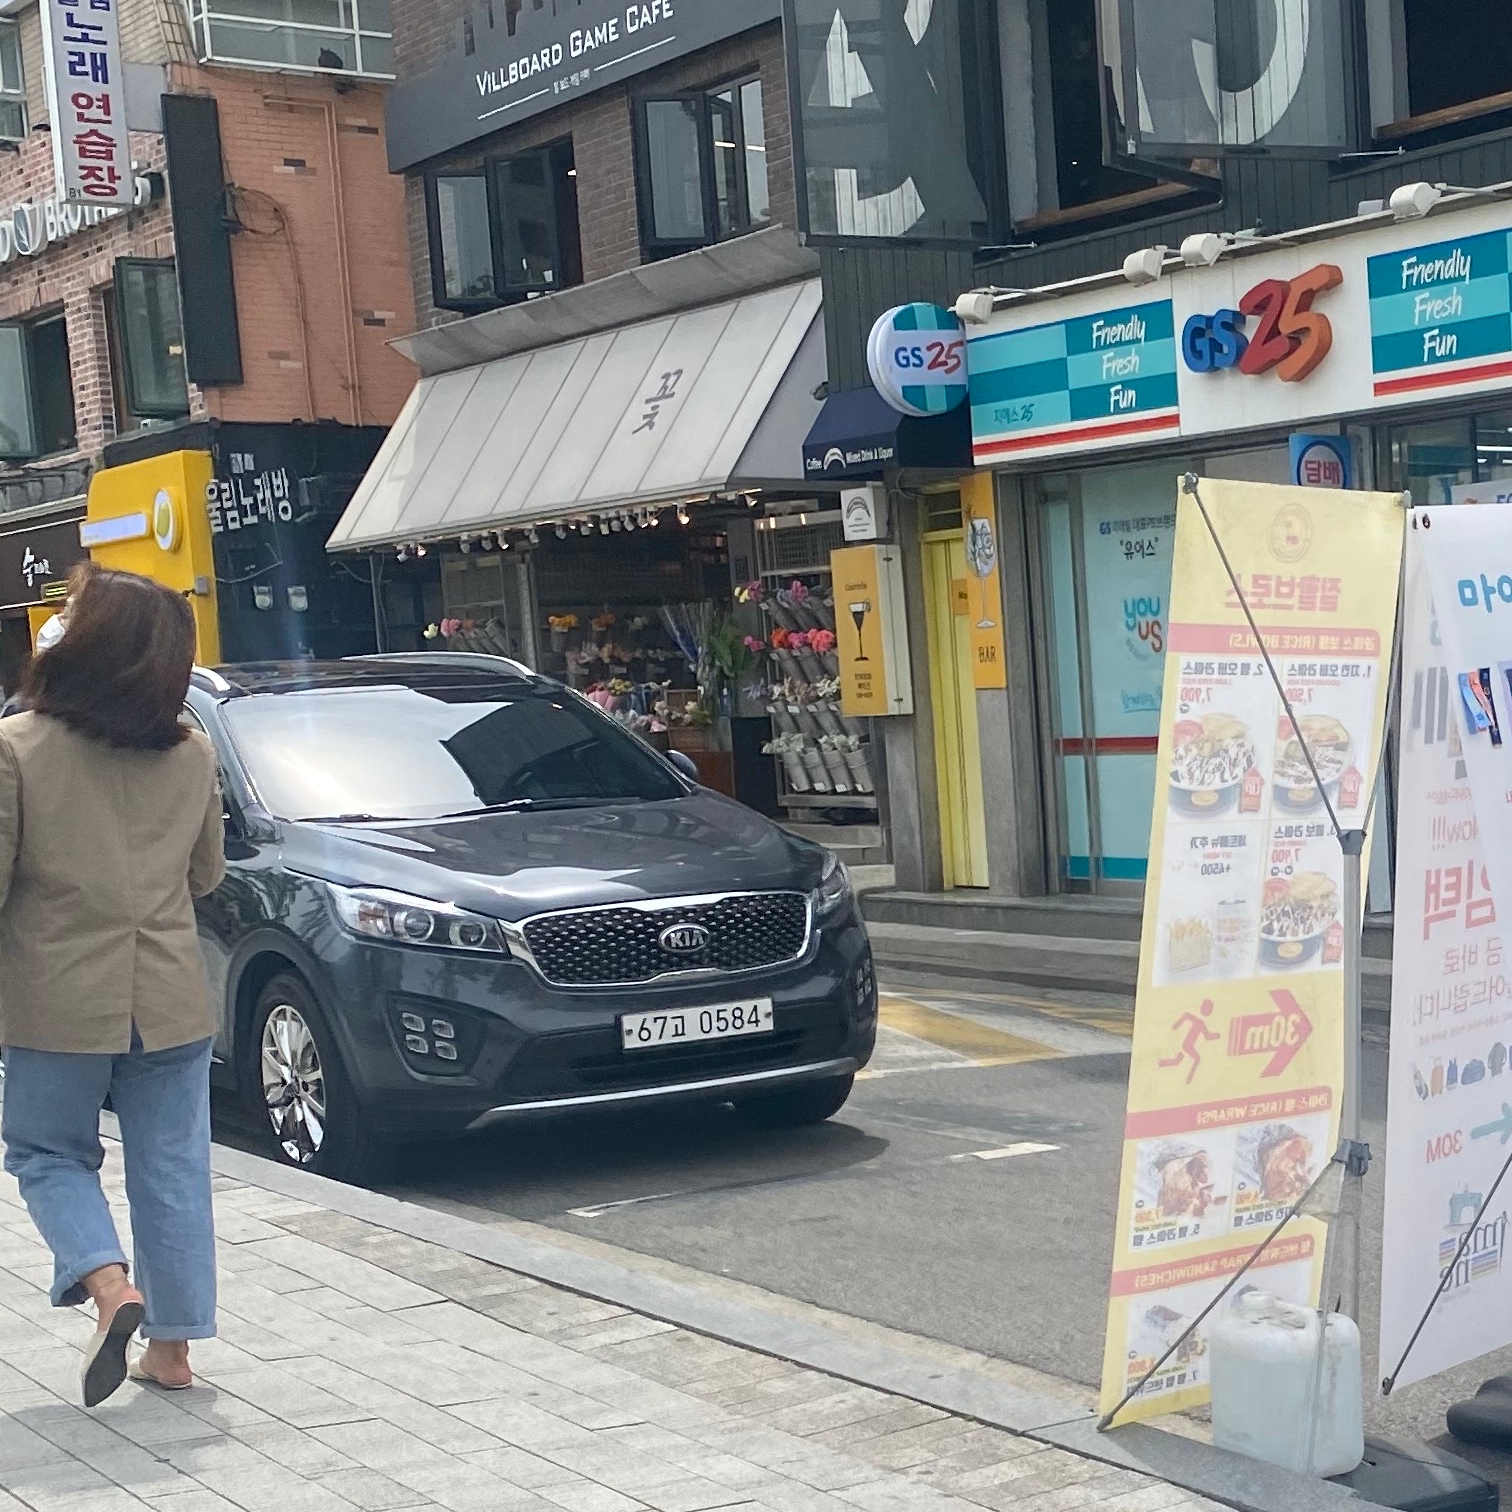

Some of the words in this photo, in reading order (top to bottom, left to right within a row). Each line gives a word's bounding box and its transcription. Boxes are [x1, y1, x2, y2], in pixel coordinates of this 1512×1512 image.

[476, 43, 563, 96] VILLBOARD
[569, 18, 619, 58] GAME
[626, 0, 674, 33] CAFE
[1401, 248, 1472, 290] Friendly
[1182, 263, 1343, 382] GS25
[1413, 288, 1463, 326] Fresh
[1092, 315, 1146, 349] Friendly
[1422, 329, 1458, 363] Fun
[895, 340, 966, 374] GS25
[1102, 350, 1139, 380] Fresh
[1109, 384, 1136, 413] Fun
[1124, 597, 1160, 631] you
[1138, 620, 1162, 652] us
[978, 645, 997, 663] BAR
[670, 929, 705, 948] KIA
[699, 1004, 761, 1034] 0584
